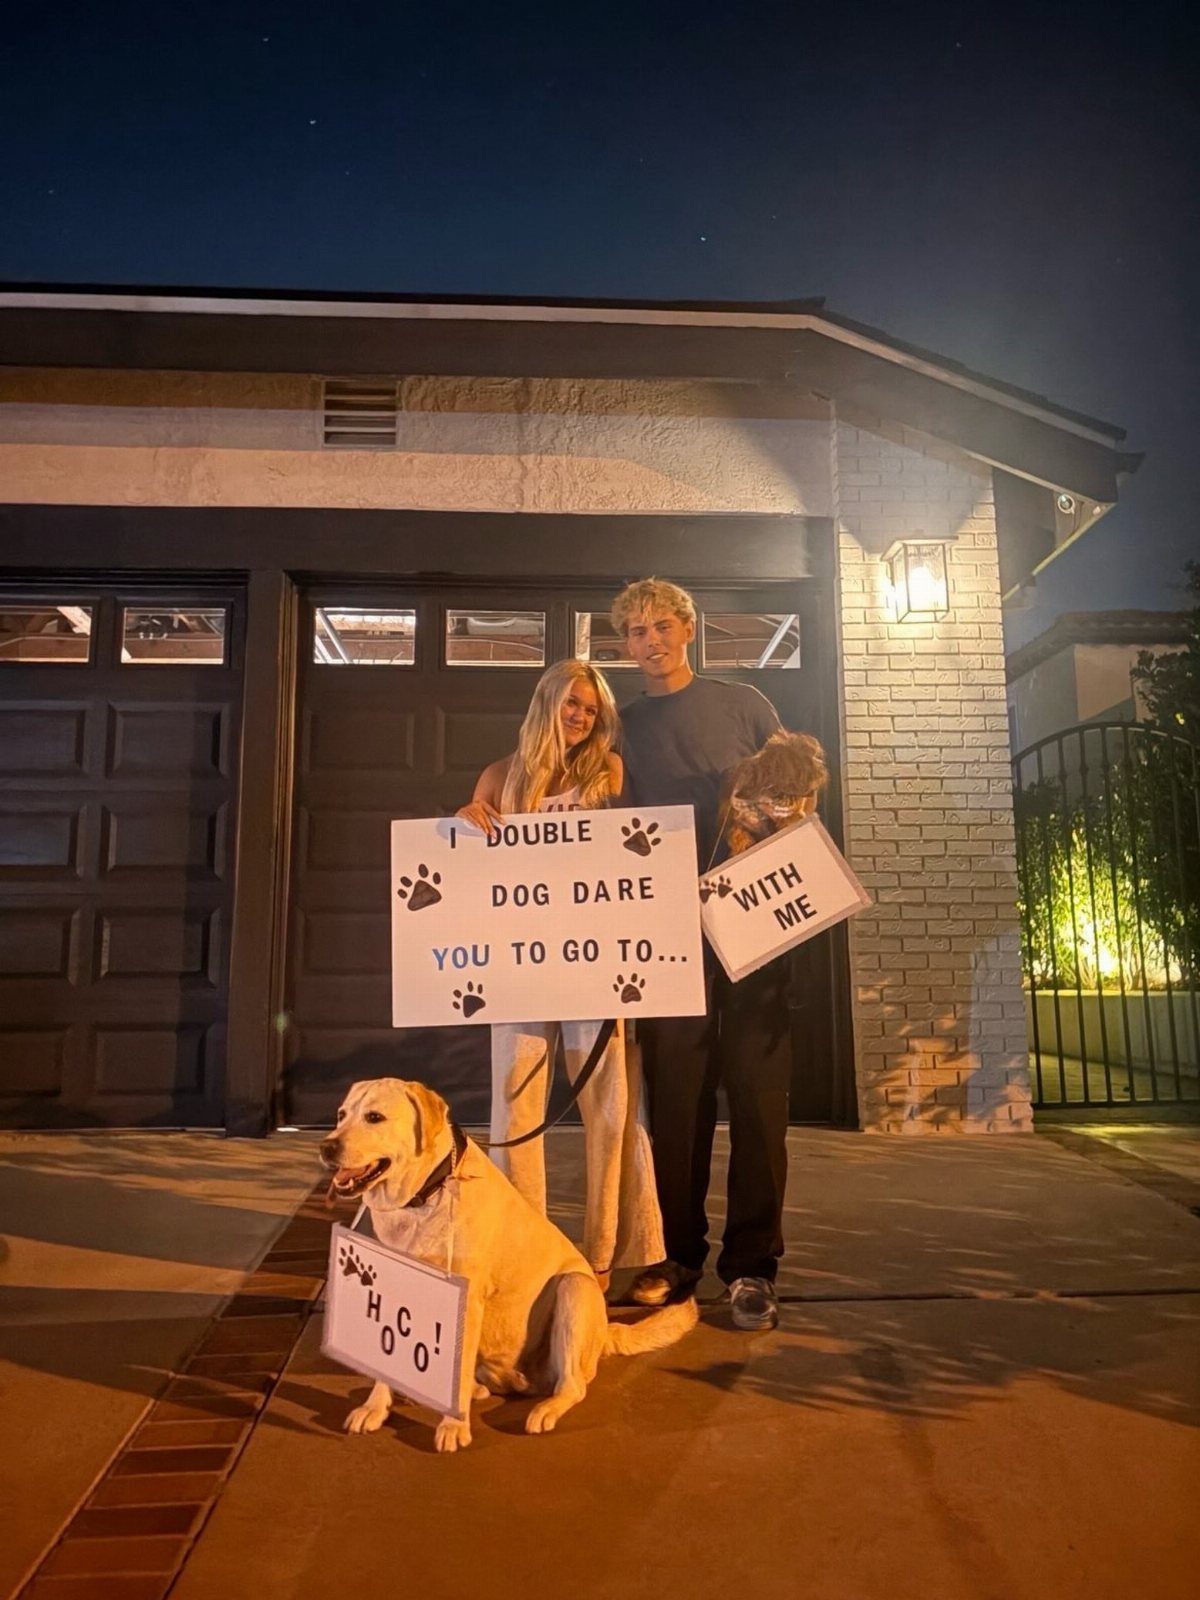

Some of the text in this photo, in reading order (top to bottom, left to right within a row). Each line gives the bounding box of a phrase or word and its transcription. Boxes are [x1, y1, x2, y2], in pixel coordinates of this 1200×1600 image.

[449, 819, 593, 849] I DOUBLE
[491, 876, 655, 907] DOG DARE
[732, 862, 803, 912] WITH
[773, 893, 818, 931] ME
[432, 938, 688, 971] YOU TO GO TO...
